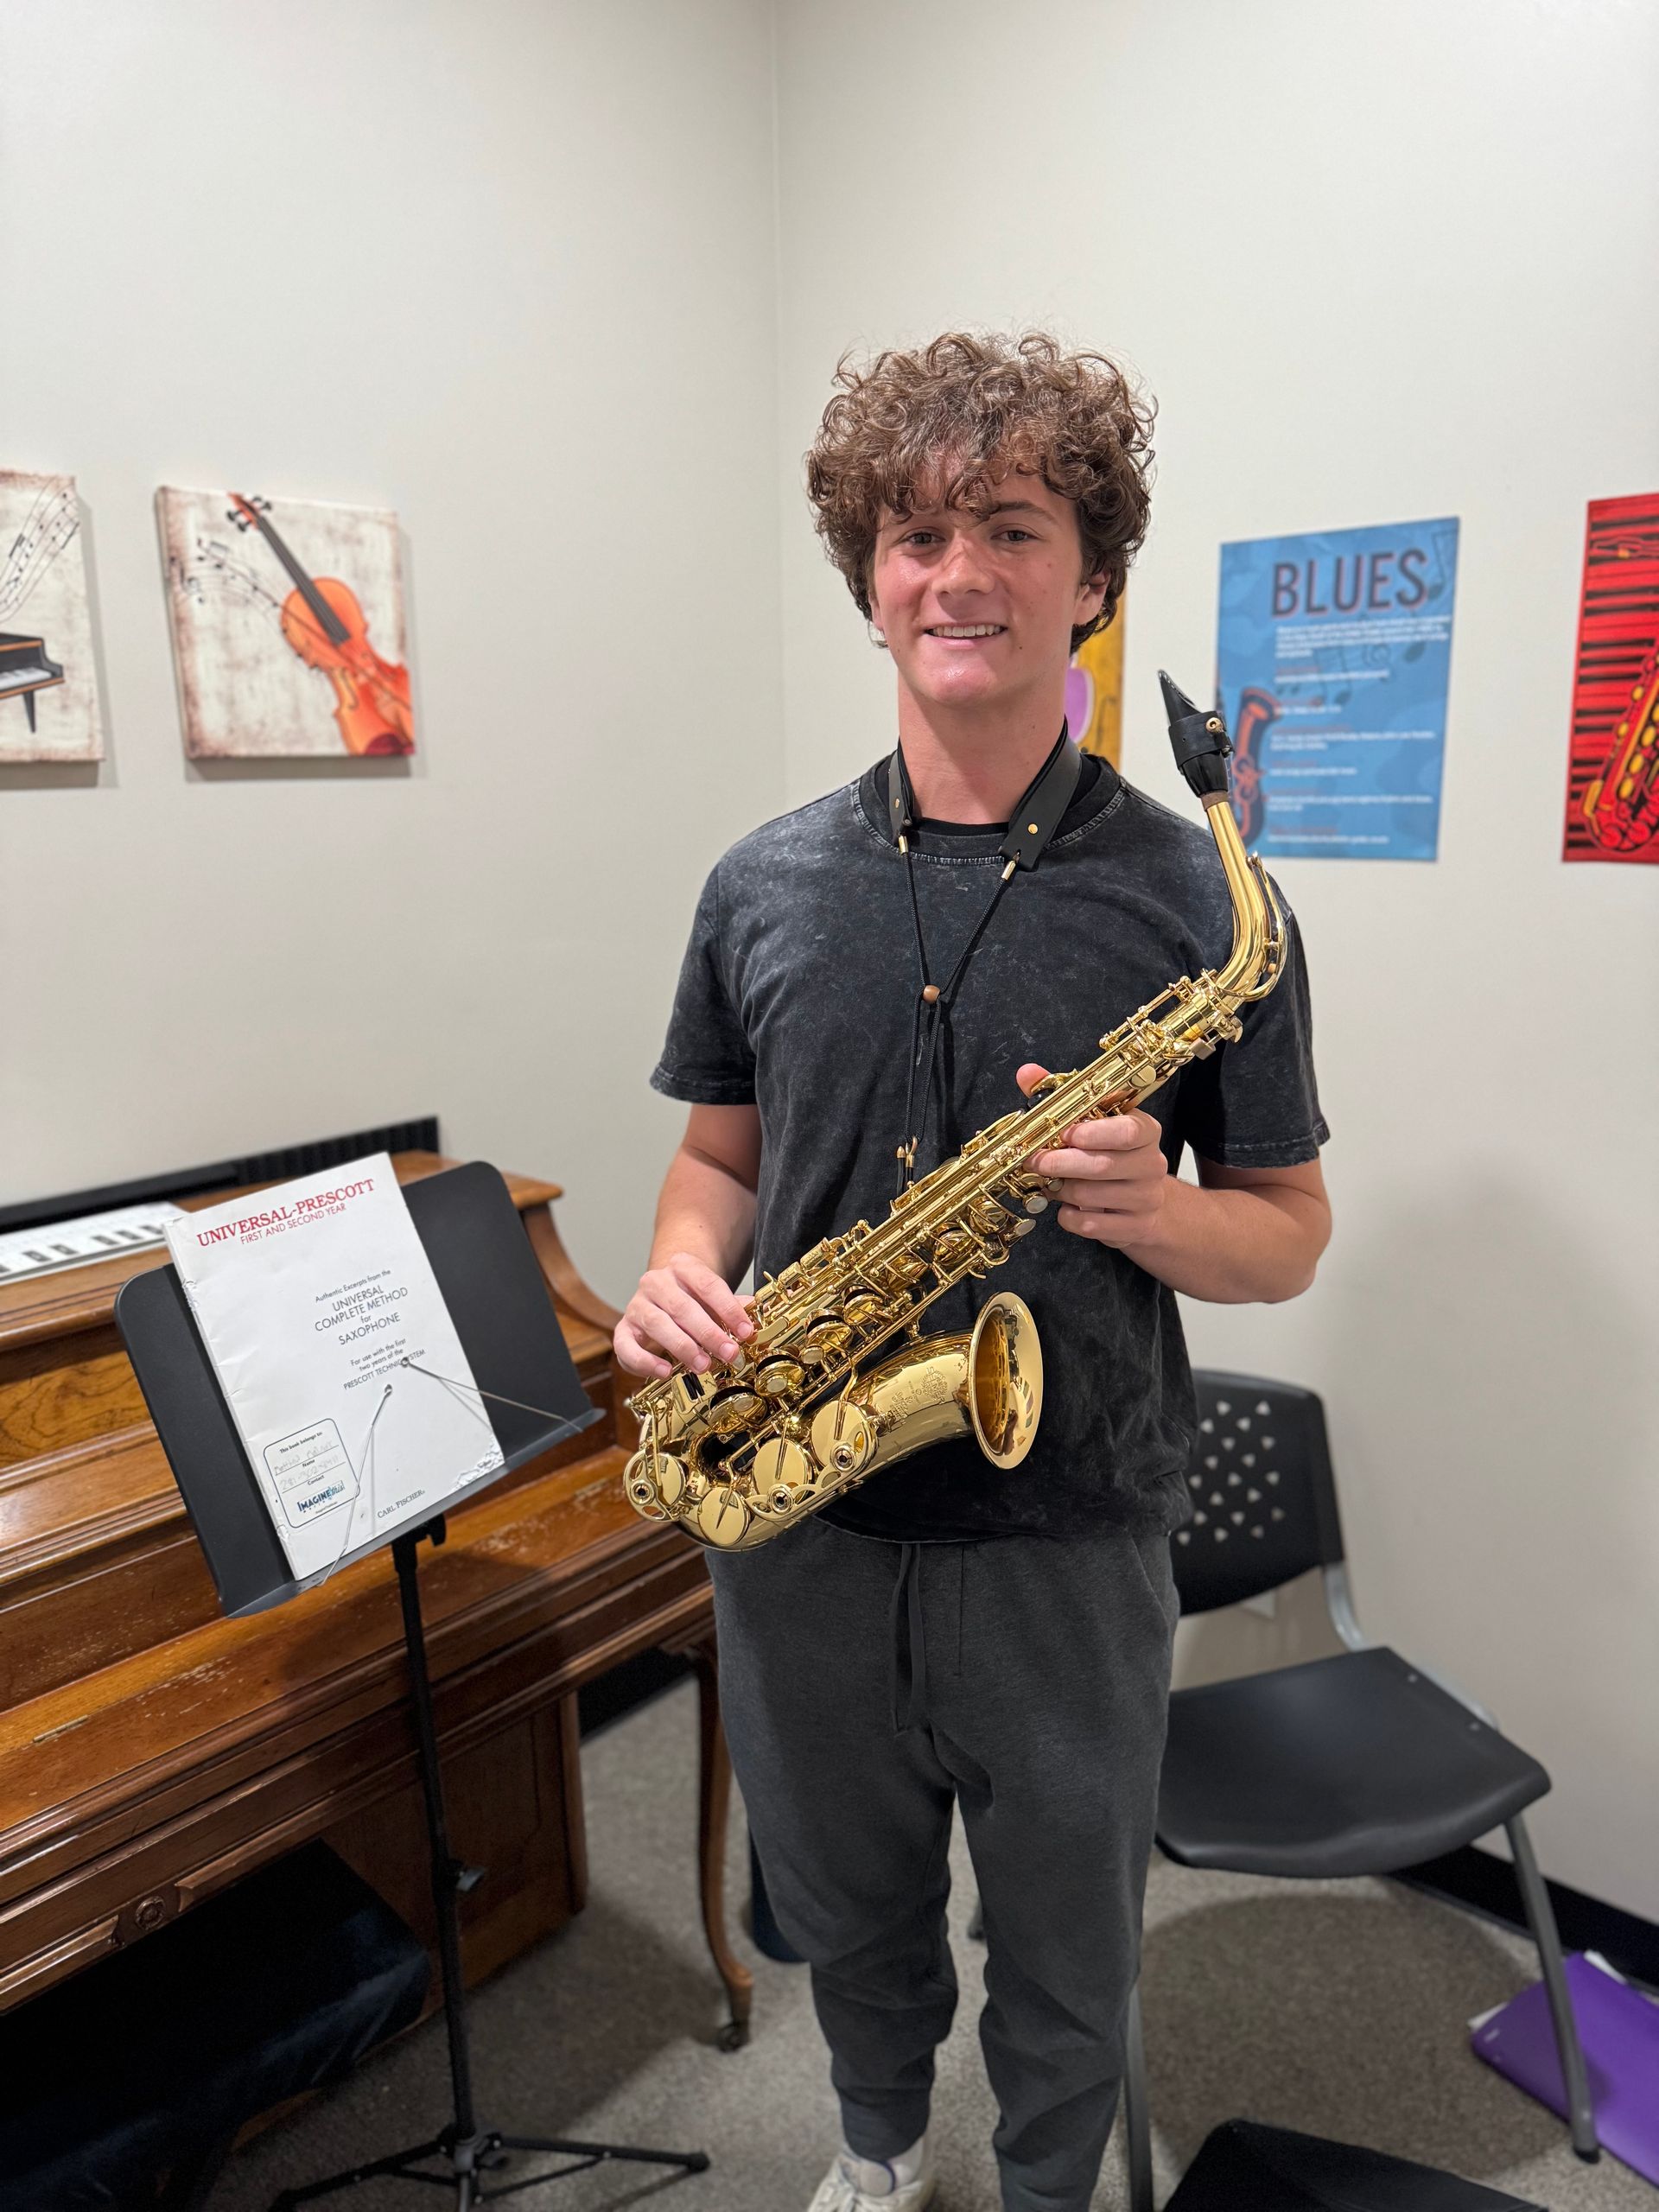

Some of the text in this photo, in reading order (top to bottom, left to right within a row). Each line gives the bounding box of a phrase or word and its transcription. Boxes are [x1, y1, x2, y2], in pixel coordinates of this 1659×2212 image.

[1272, 548, 1428, 618] BLUES
[196, 1179, 374, 1247] UNIVERSAL-PRESCOTT
[240, 1203, 346, 1244] FIRST AND SECOND YEAR
[315, 1287, 343, 1303] Authentic
[343, 1279, 368, 1292] Excerpts
[367, 1273, 381, 1282] from
[332, 1285, 384, 1312] UNIVERSAL
[315, 1287, 408, 1332] COMPLETE METHOD
[360, 1315, 372, 1324] for
[338, 1312, 401, 1345] SAXOPHONE
[395, 1338, 407, 1347] first
[343, 1371, 374, 1389] PRESCOTT
[375, 1358, 402, 1376] TECHNIC
[372, 1357, 387, 1368] years
[289, 1441, 300, 1450] book
[299, 1433, 316, 1445] belongs
[307, 1475, 325, 1486] Contact
[377, 1505, 397, 1518] CARL
